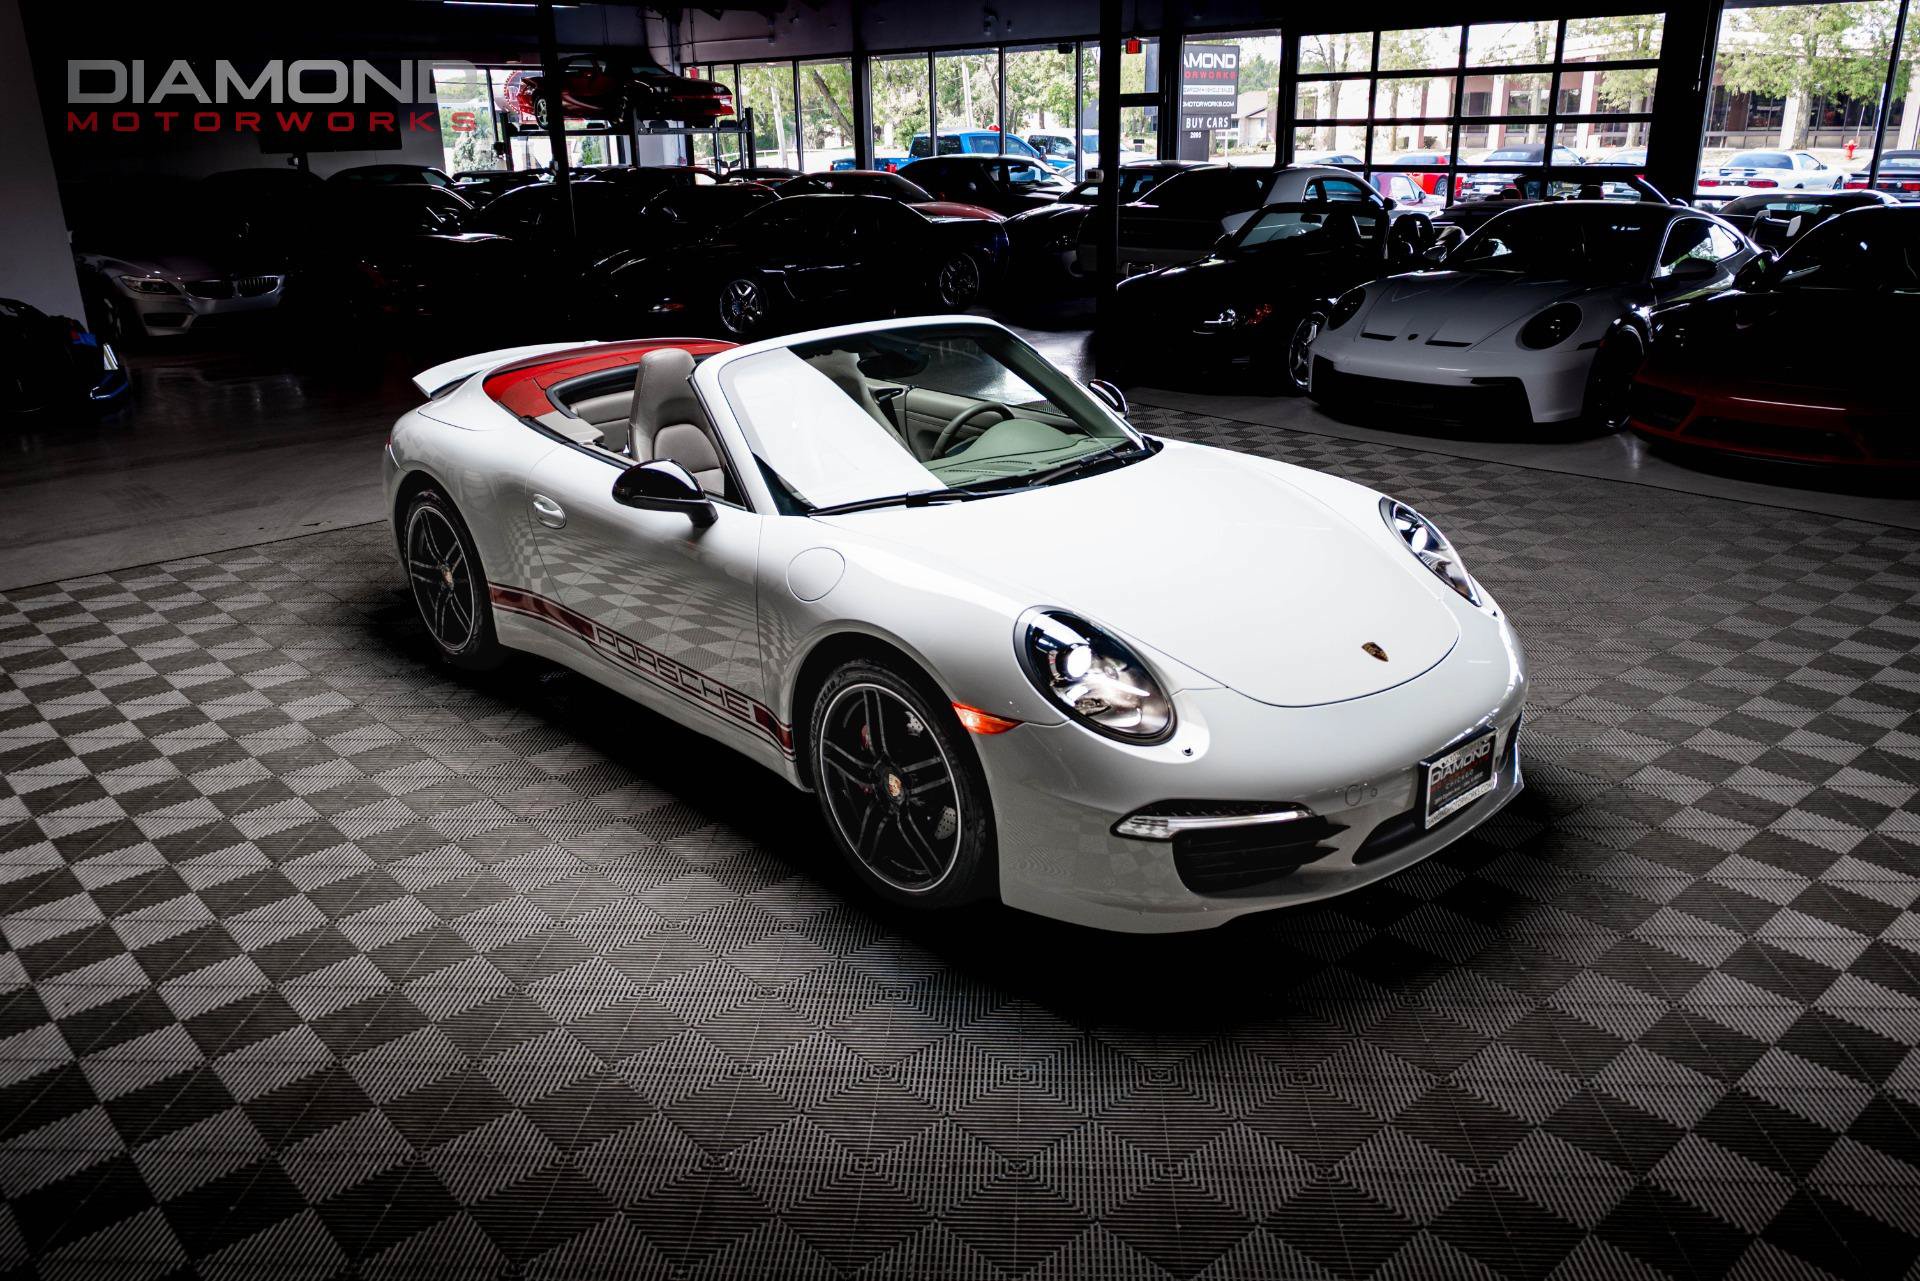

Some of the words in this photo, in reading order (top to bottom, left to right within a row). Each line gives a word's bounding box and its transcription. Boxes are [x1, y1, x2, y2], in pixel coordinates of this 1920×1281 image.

[1185, 117, 1203, 129] BUY
[1206, 116, 1229, 128] CARS
[596, 626, 752, 720] PORSCHE
[1431, 741, 1491, 787] DIAMOND
